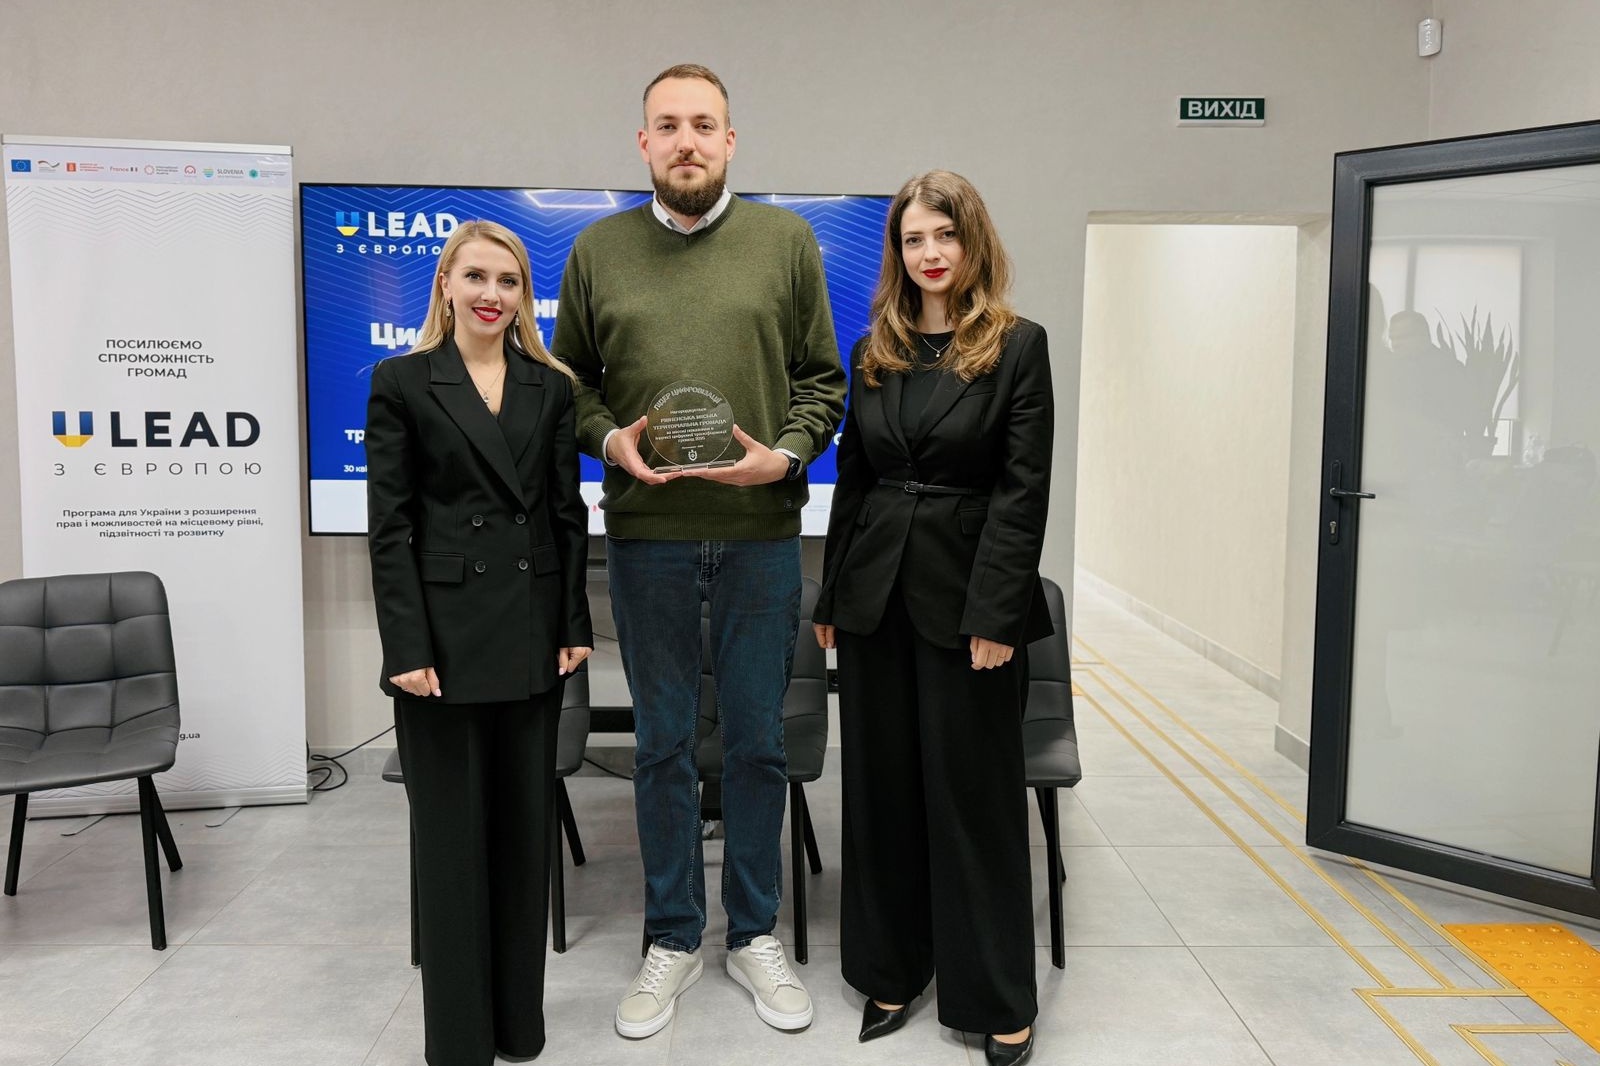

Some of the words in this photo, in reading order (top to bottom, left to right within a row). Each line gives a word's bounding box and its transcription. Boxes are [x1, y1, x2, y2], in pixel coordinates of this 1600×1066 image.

[1188, 100, 1256, 118] ВИХІД
[368, 211, 459, 238] LEAD
[358, 244, 442, 255] ЄВРОПО
[370, 322, 421, 350] Ци
[106, 340, 202, 350] ПОСИЛЮЄМО
[98, 354, 214, 364] СПРОМОЖНІСТЬ
[127, 368, 187, 379] ГРОМАД
[110, 411, 260, 447] LEAD
[344, 429, 365, 444] тр
[94, 462, 262, 476] ЄВРОПОЮ
[343, 464, 355, 473] 30
[355, 464, 368, 473] кві
[63, 510, 116, 518] Програма
[140, 508, 181, 517] України
[56, 521, 82, 529] прав
[91, 519, 162, 527] можливостей
[180, 518, 234, 527] місцевому
[237, 517, 264, 526] рівні,
[99, 529, 161, 537] підзвітності
[177, 530, 224, 538] розвитку
